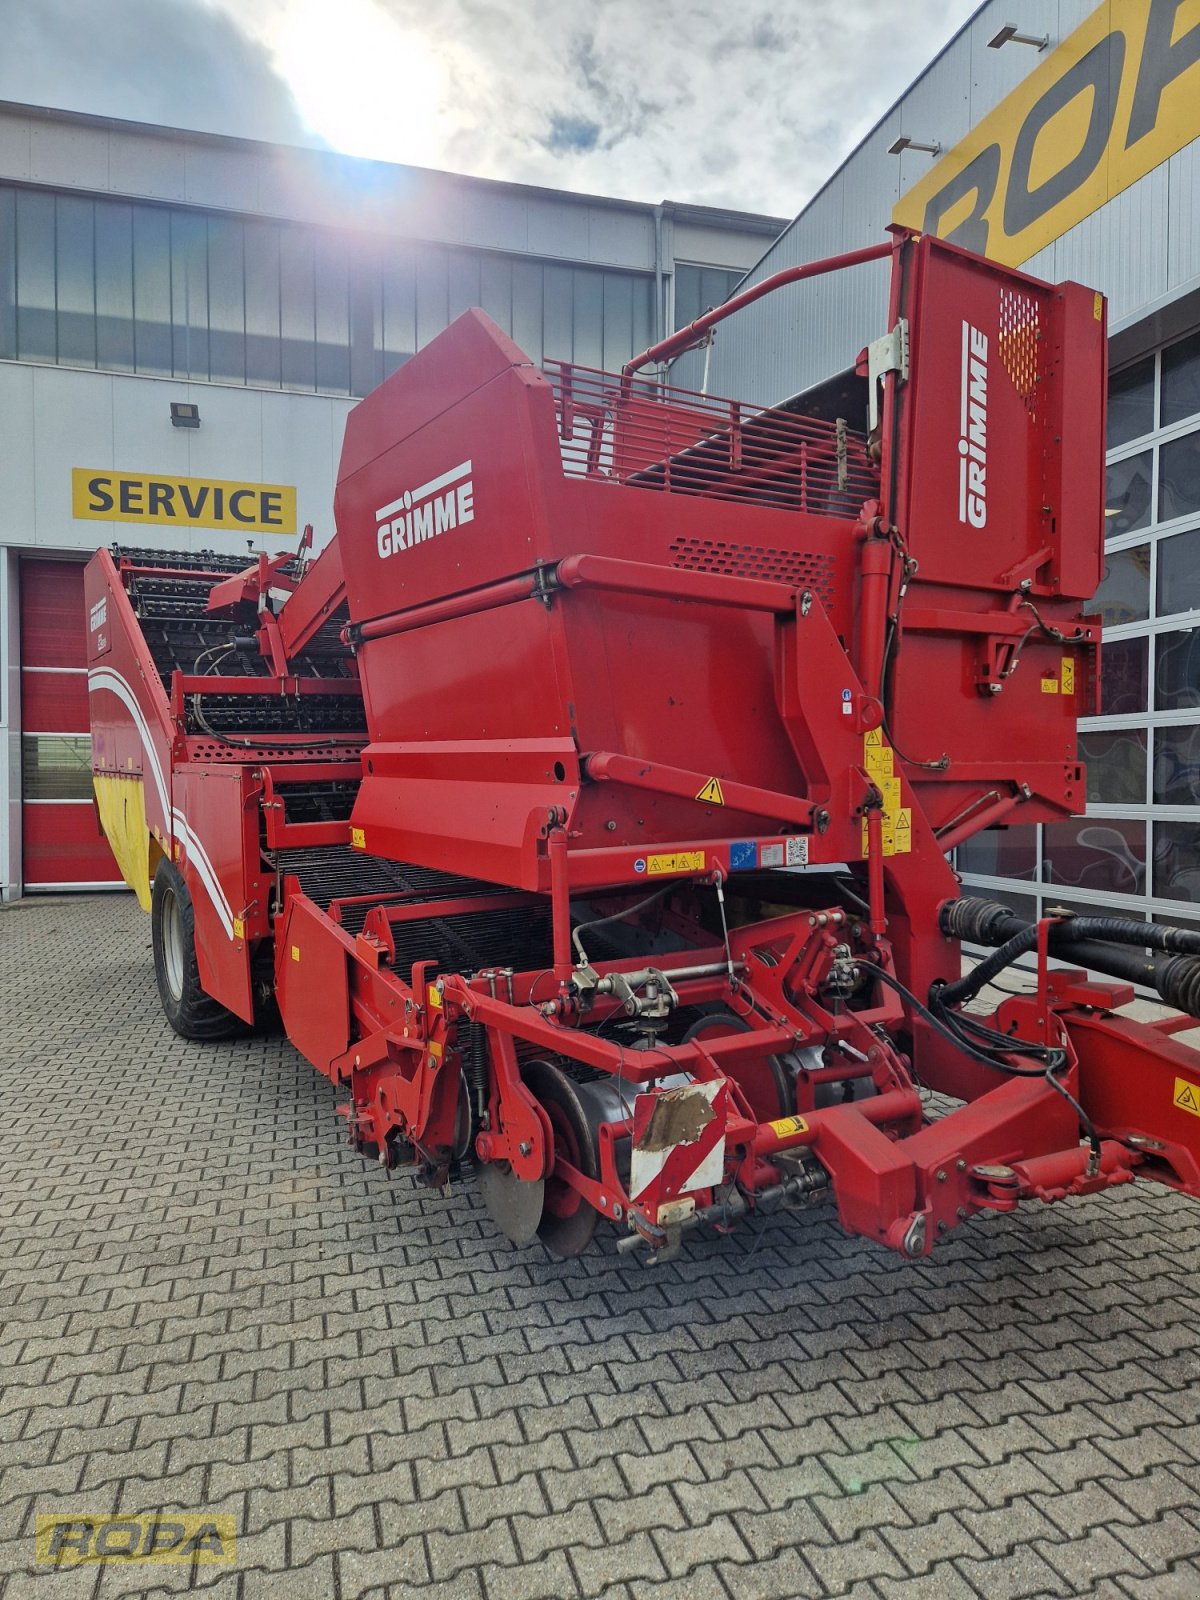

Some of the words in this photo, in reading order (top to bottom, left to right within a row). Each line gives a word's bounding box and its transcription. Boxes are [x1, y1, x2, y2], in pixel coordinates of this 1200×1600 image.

[958, 323, 988, 529] GRIMME
[88, 477, 283, 525] SERVICE
[376, 479, 475, 559] GRIMME
